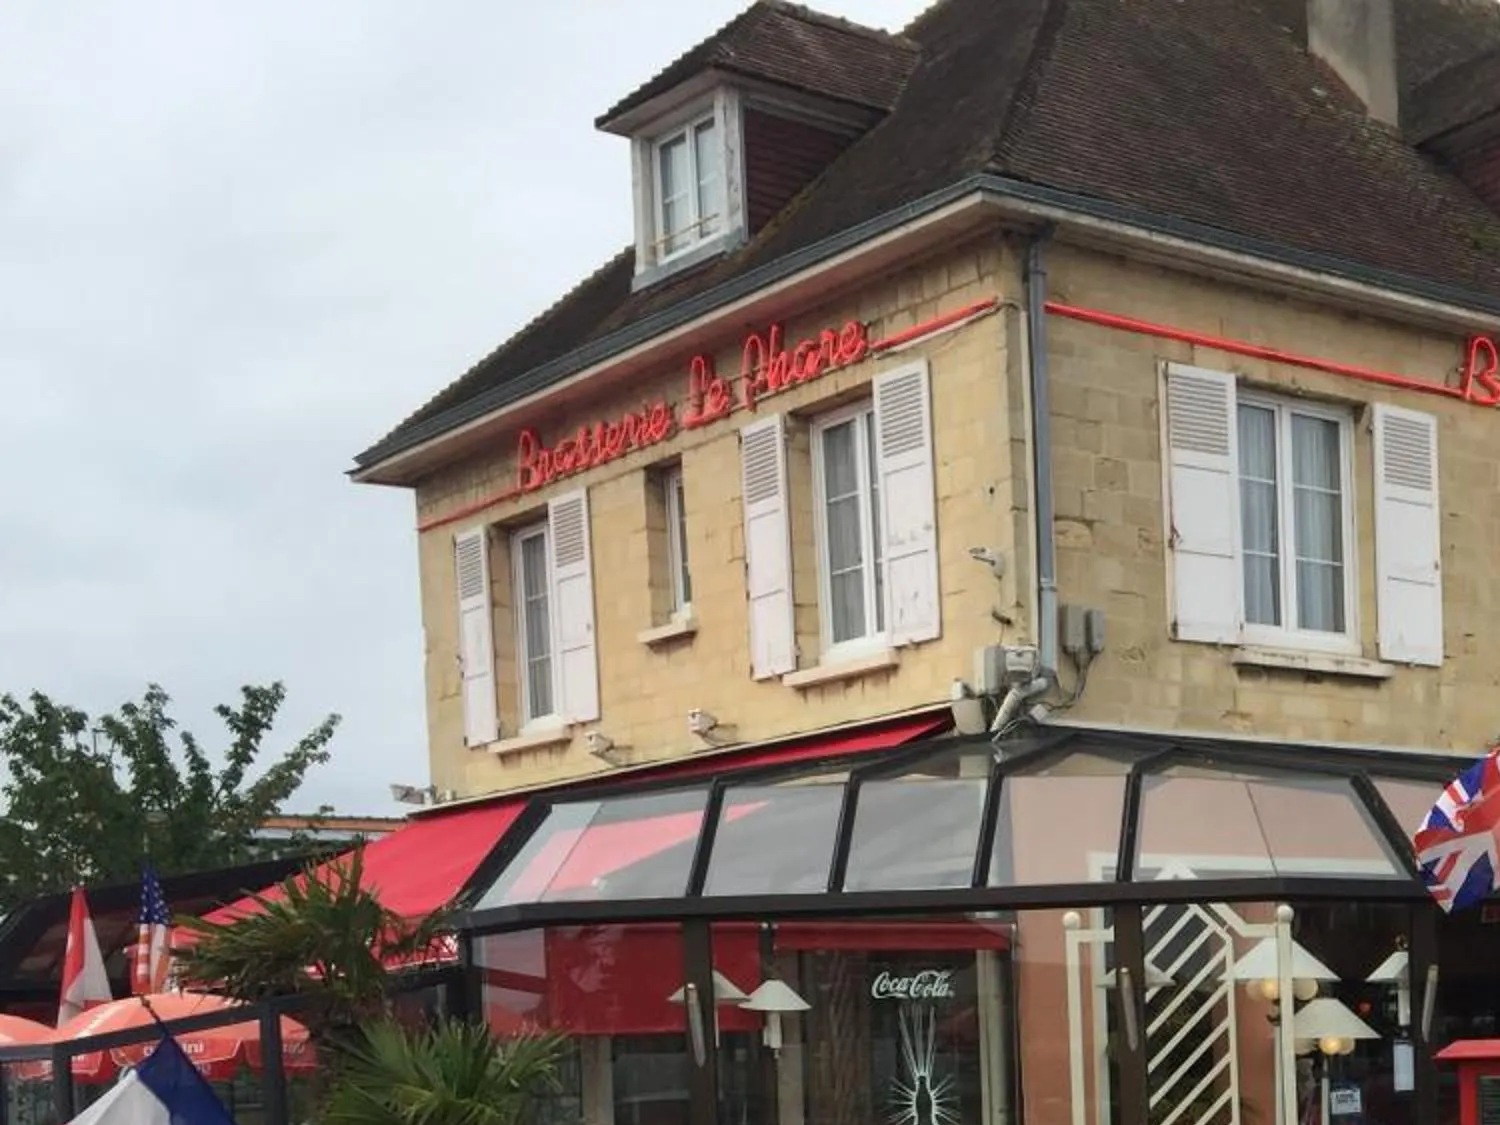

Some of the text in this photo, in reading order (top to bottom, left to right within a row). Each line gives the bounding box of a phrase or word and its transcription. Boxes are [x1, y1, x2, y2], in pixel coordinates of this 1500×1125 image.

[519, 320, 868, 490] Brasserie Le Phare
[871, 969, 955, 999] Coca-Cola
